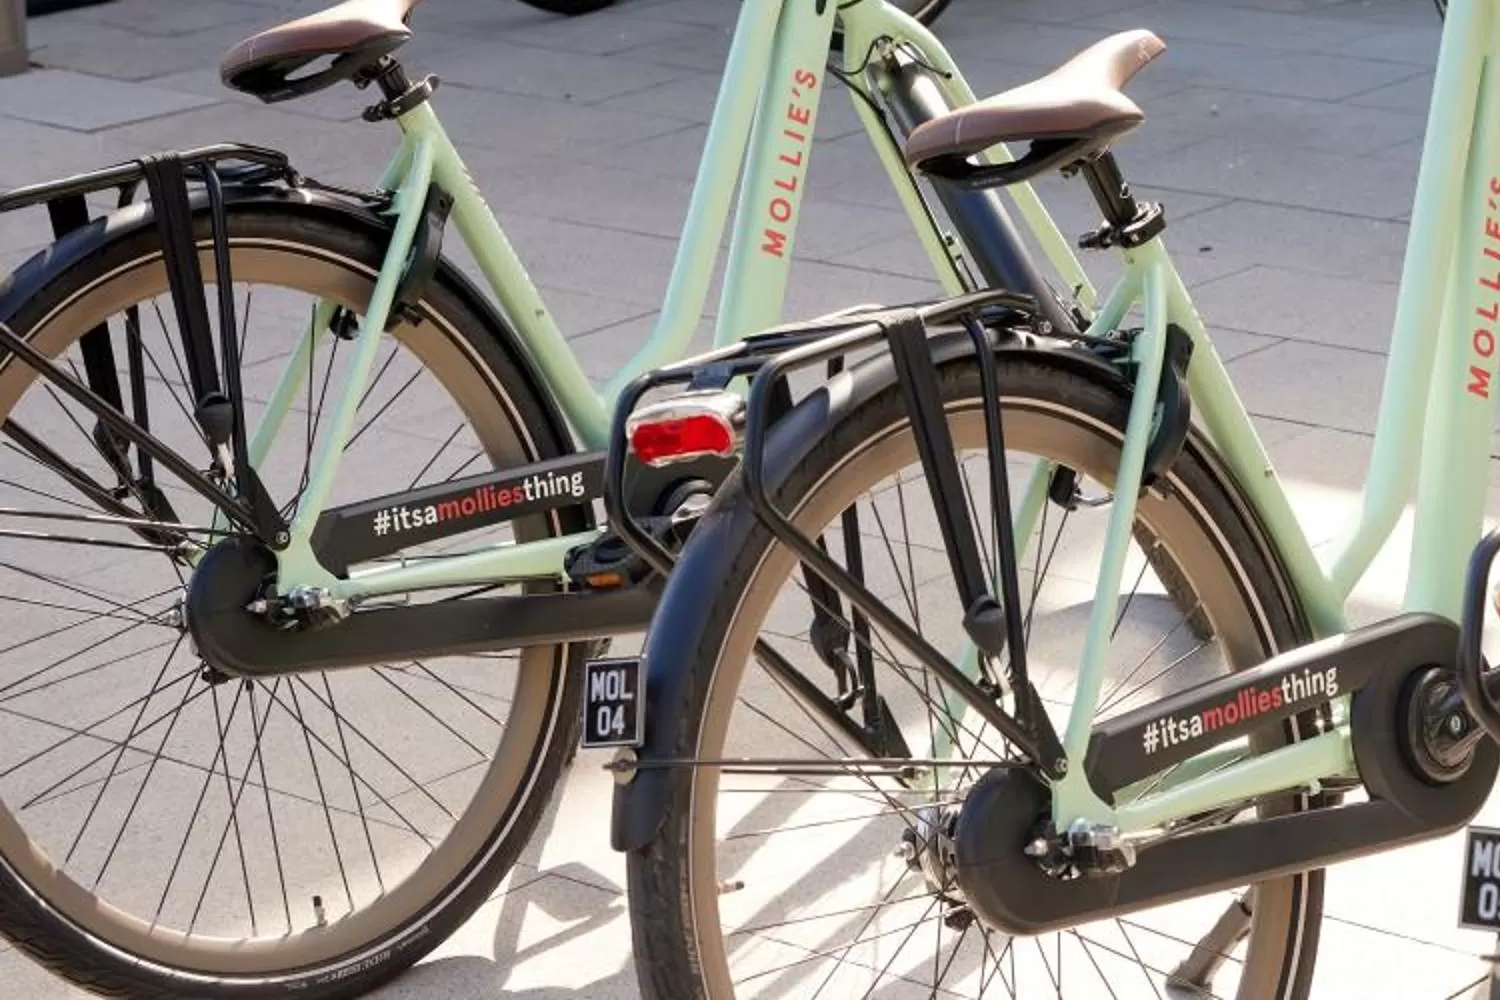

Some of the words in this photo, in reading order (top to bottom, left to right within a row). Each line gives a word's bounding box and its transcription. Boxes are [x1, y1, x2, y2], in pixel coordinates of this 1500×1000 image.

[761, 67, 817, 258] MOLLIE'S
[373, 470, 585, 537] #itsamolliesthing
[591, 669, 634, 703] MOL
[1142, 666, 1340, 755] #itsamolliesthing
[597, 704, 625, 737] 04
